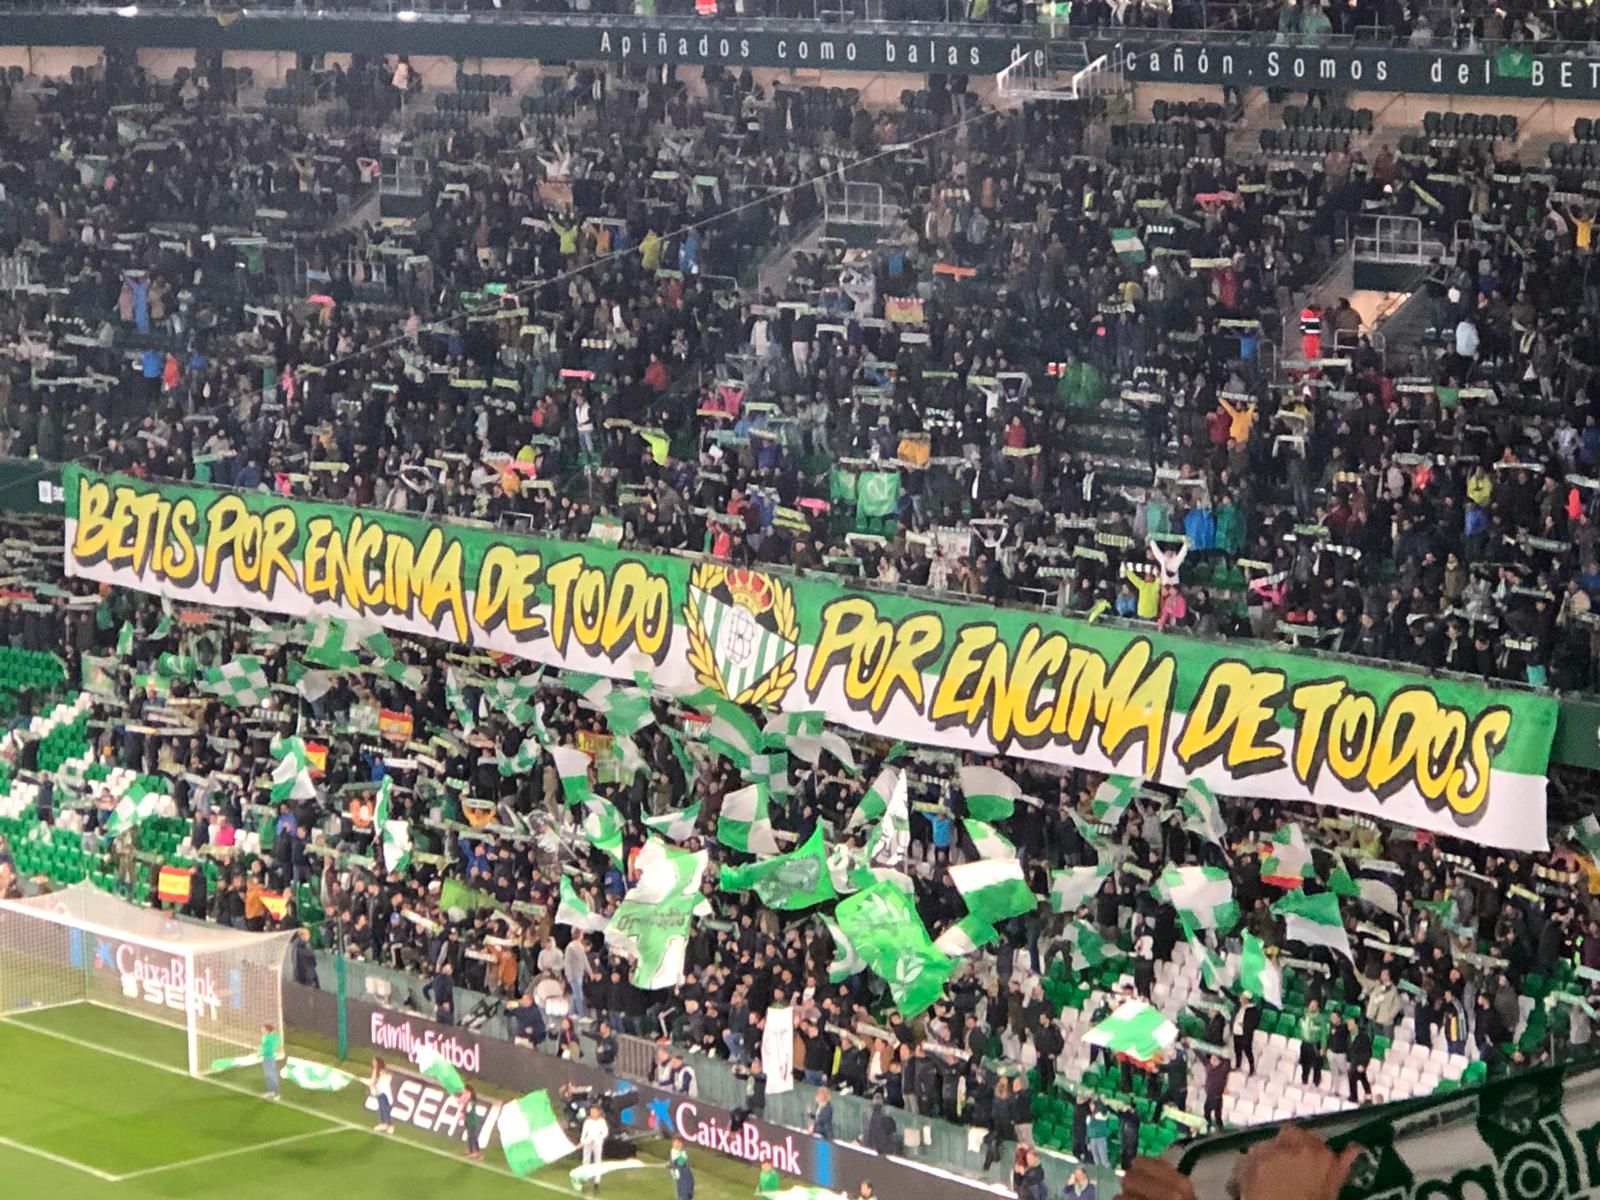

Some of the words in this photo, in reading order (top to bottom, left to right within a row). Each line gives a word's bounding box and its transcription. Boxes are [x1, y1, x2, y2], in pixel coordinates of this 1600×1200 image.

[600, 31, 750, 57] Apiñados
[777, 39, 857, 61] como
[886, 39, 980, 65] balas
[1011, 43, 1044, 68] de
[1431, 51, 1491, 85] del
[1532, 60, 1600, 88] BET
[72, 475, 197, 586] BETIS
[202, 494, 300, 598] POR
[303, 514, 470, 642] ENCIMA
[473, 543, 549, 641] DE
[545, 554, 673, 665] TODO
[805, 595, 944, 723] POR
[928, 621, 1177, 781] ENCIMA
[1173, 658, 1287, 778] DE
[1289, 676, 1512, 826] TODOS
[116, 944, 215, 998] CaixaBnk
[371, 1012, 421, 1063] Family
[676, 1101, 801, 1175] CaixaBank
